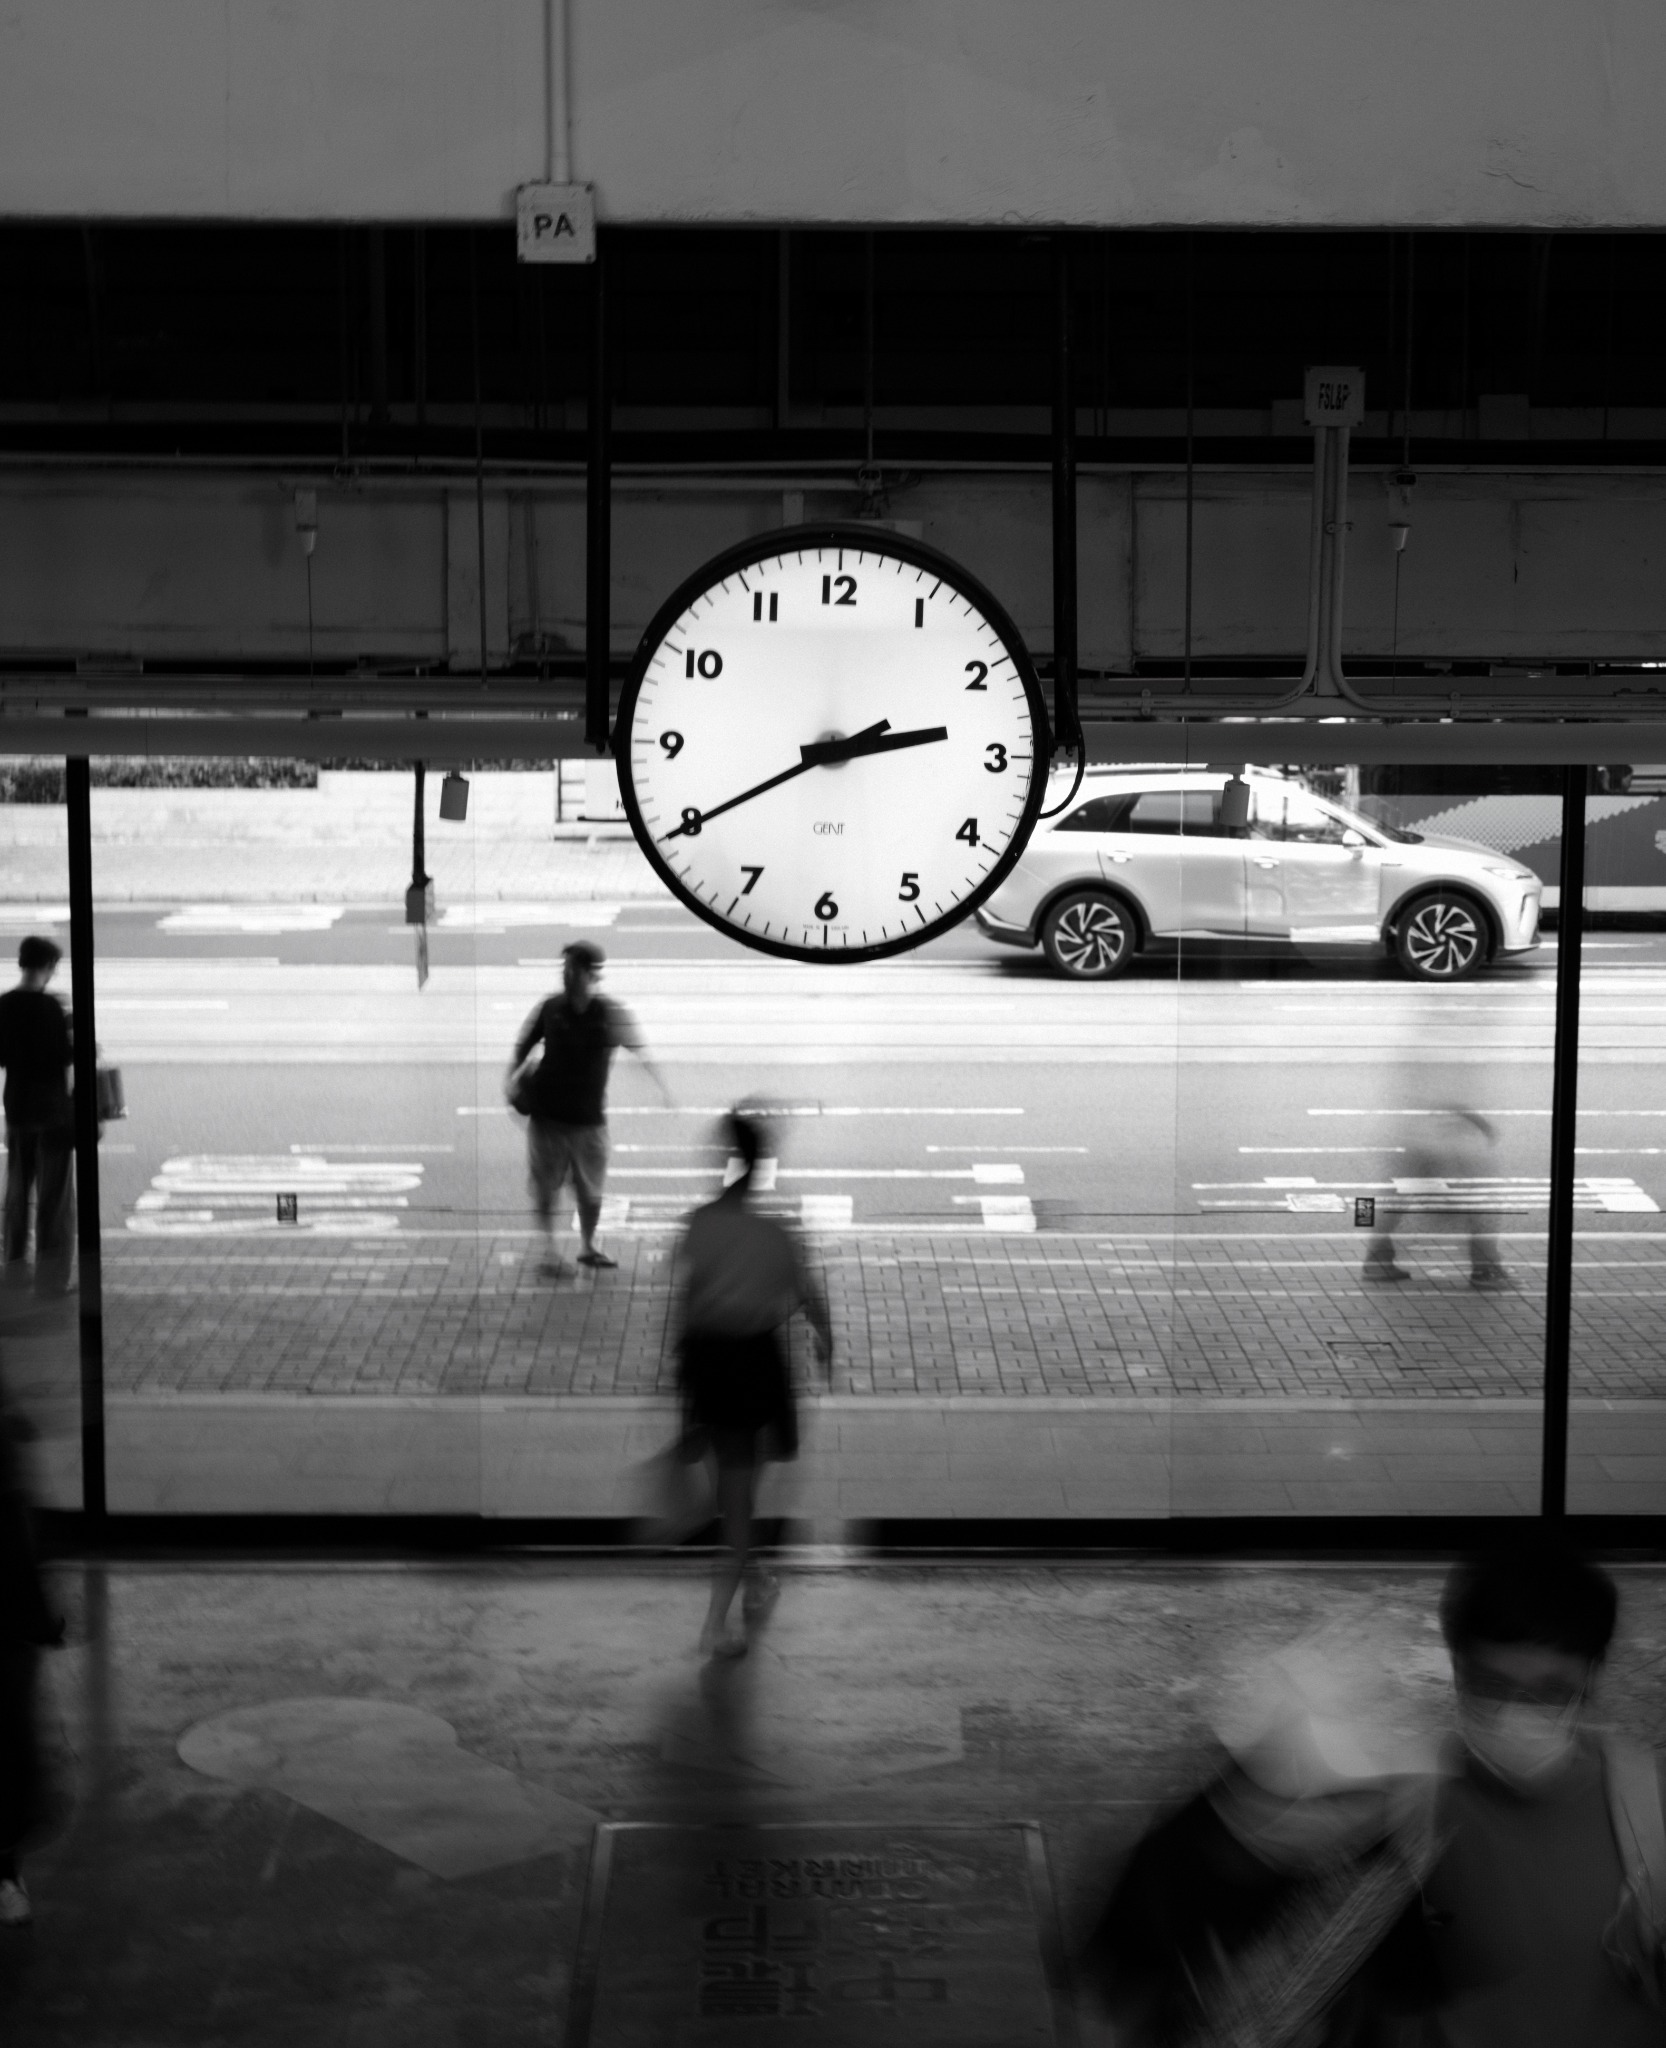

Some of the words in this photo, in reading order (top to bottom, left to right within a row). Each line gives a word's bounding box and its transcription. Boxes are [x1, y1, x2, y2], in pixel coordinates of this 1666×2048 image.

[534, 212, 575, 240] PA
[821, 575, 857, 606] 12
[753, 591, 778, 622] 11
[915, 598, 924, 628] 1
[685, 649, 723, 680] 10
[965, 660, 988, 691] 2
[659, 731, 684, 759] 9
[983, 743, 1008, 773] 3
[680, 807, 702, 836] 8
[813, 821, 845, 836] GENT
[956, 818, 980, 846] 4
[741, 866, 764, 895] 7
[898, 872, 920, 901] 5
[814, 891, 839, 921] 6
